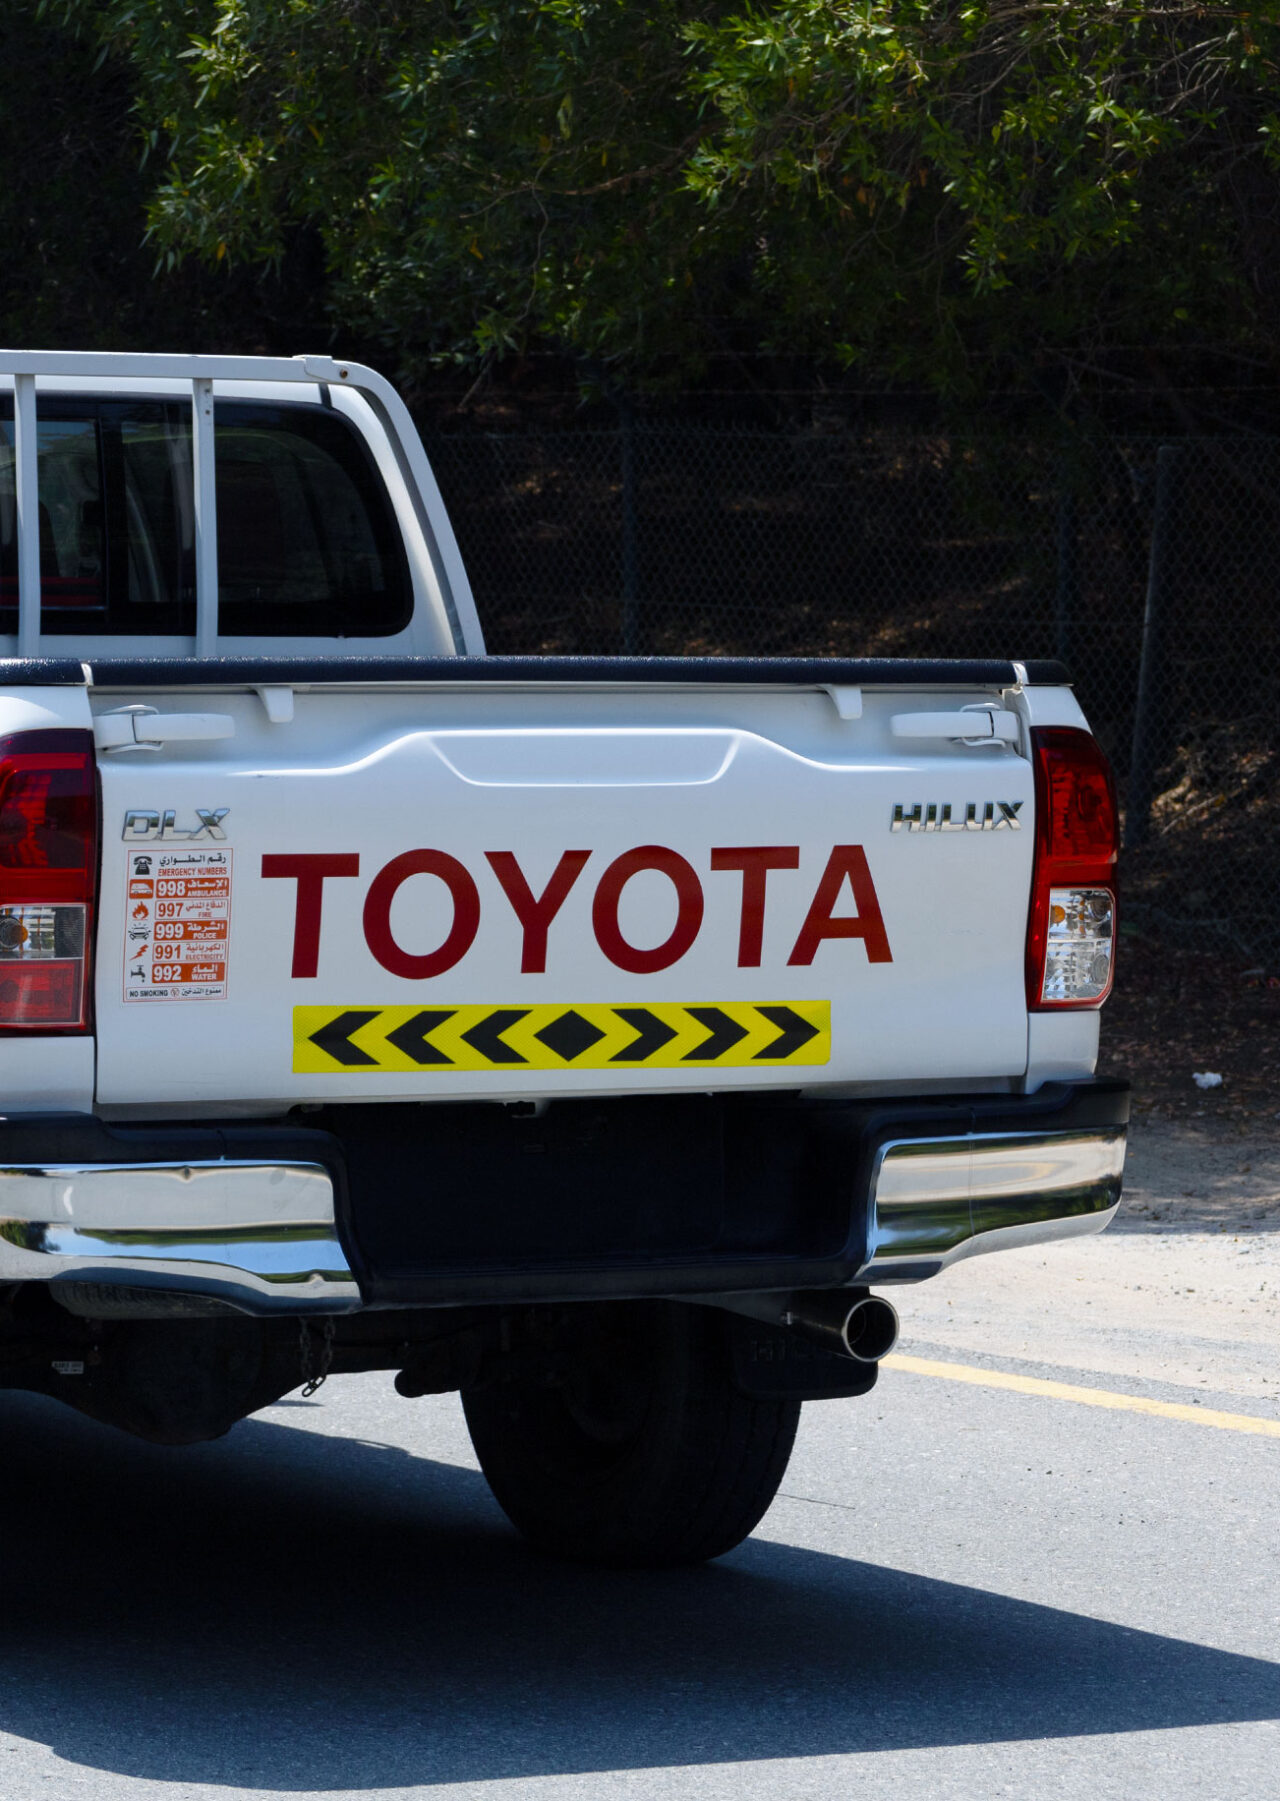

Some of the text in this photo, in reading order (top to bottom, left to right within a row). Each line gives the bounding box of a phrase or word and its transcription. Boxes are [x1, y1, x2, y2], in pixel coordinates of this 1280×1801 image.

[121, 807, 230, 841] DLX
[889, 800, 1024, 833] HILUX
[158, 866, 228, 877] EMERGENCY NUMBERS
[158, 881, 186, 897] 998
[187, 889, 227, 897] AMBULANCE
[158, 902, 184, 917] 997
[261, 844, 894, 980] TOYOTA
[155, 923, 184, 939] 999
[154, 944, 182, 960] 991
[153, 965, 182, 982] 992
[191, 973, 218, 981] WATER
[140, 989, 169, 997] SMOKING
